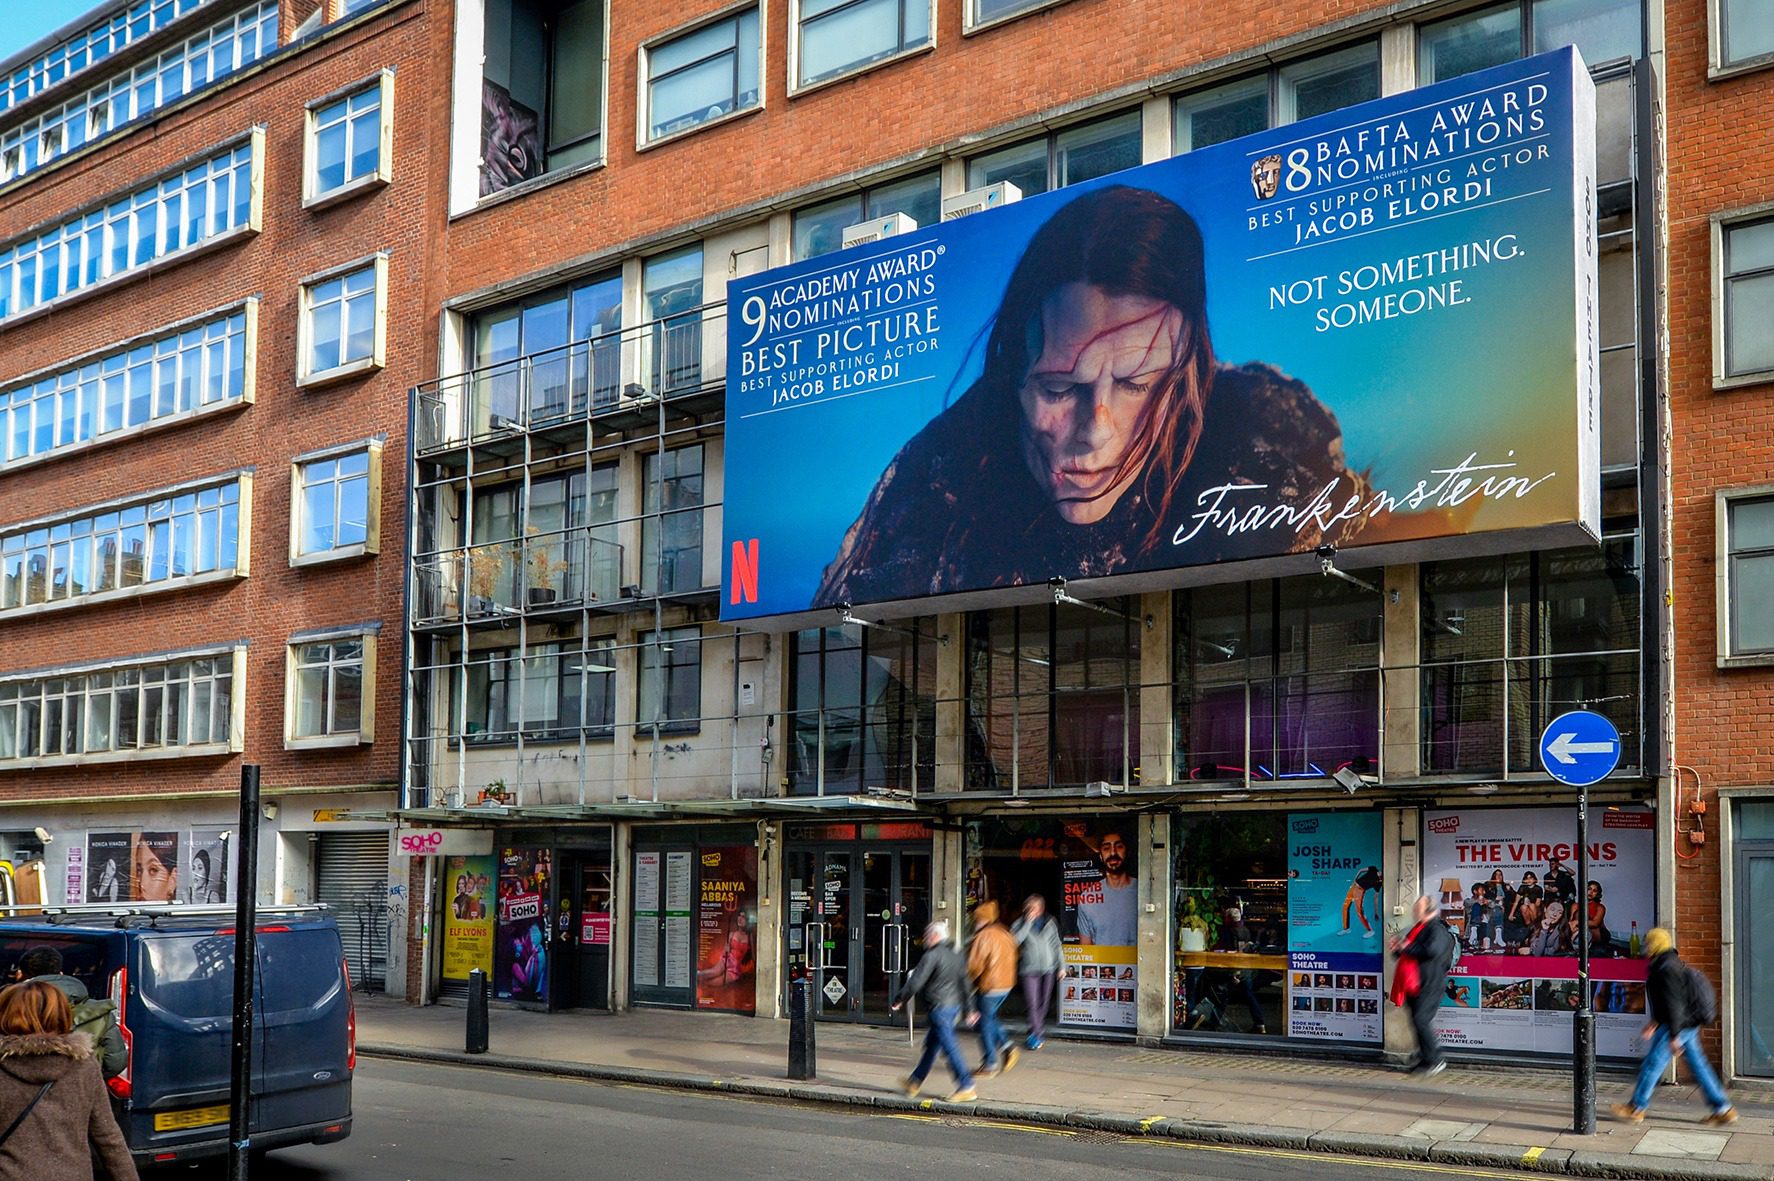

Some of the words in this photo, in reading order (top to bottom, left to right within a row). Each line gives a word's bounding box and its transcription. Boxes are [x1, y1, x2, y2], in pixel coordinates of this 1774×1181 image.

[1285, 148, 1311, 191] 8
[1317, 121, 1410, 163] BAFTA
[1431, 84, 1548, 134] AWARD
[1317, 109, 1545, 186] NOMINATIONS
[1372, 167, 1409, 182] INCLUDING
[1248, 207, 1296, 231] BEST
[1309, 168, 1452, 216] SUPPORTING
[1467, 144, 1550, 178] ACTOR
[1295, 207, 1375, 245] JACOB
[1389, 177, 1492, 219] ELORDI
[1269, 276, 1328, 310] NOT
[1337, 234, 1526, 295] SOMETHING.
[741, 296, 766, 347] 9
[769, 268, 860, 309] ACADEMY
[769, 274, 936, 333] NOMINATIONS
[1315, 280, 1472, 332] SOMEONE.
[742, 339, 802, 376] BEST
[817, 306, 940, 359] PICTURE
[741, 375, 773, 393] BEST
[781, 352, 875, 384] SUPPORTING
[884, 338, 939, 361] ACTOR
[772, 380, 824, 407] JACOB
[833, 362, 899, 391] ELORDI
[1173, 450, 1556, 545] Frankenstein
[731, 538, 759, 605] N
[1293, 820, 1317, 830] SOHO
[1429, 818, 1458, 829] SOHO
[401, 832, 442, 850] SOHO
[1293, 846, 1331, 857] JOSH
[1456, 844, 1501, 862] THE
[1508, 843, 1616, 862] VIRGINS
[1312, 858, 1361, 869] SHARP
[702, 882, 745, 892] SAANIYA
[1064, 882, 1102, 894] SAHIB
[701, 892, 734, 902] ABBAS
[1065, 894, 1104, 905] SINGH
[511, 905, 537, 917] SOHO
[449, 928, 461, 936] ELF
[1292, 961, 1328, 969] THEATRE
